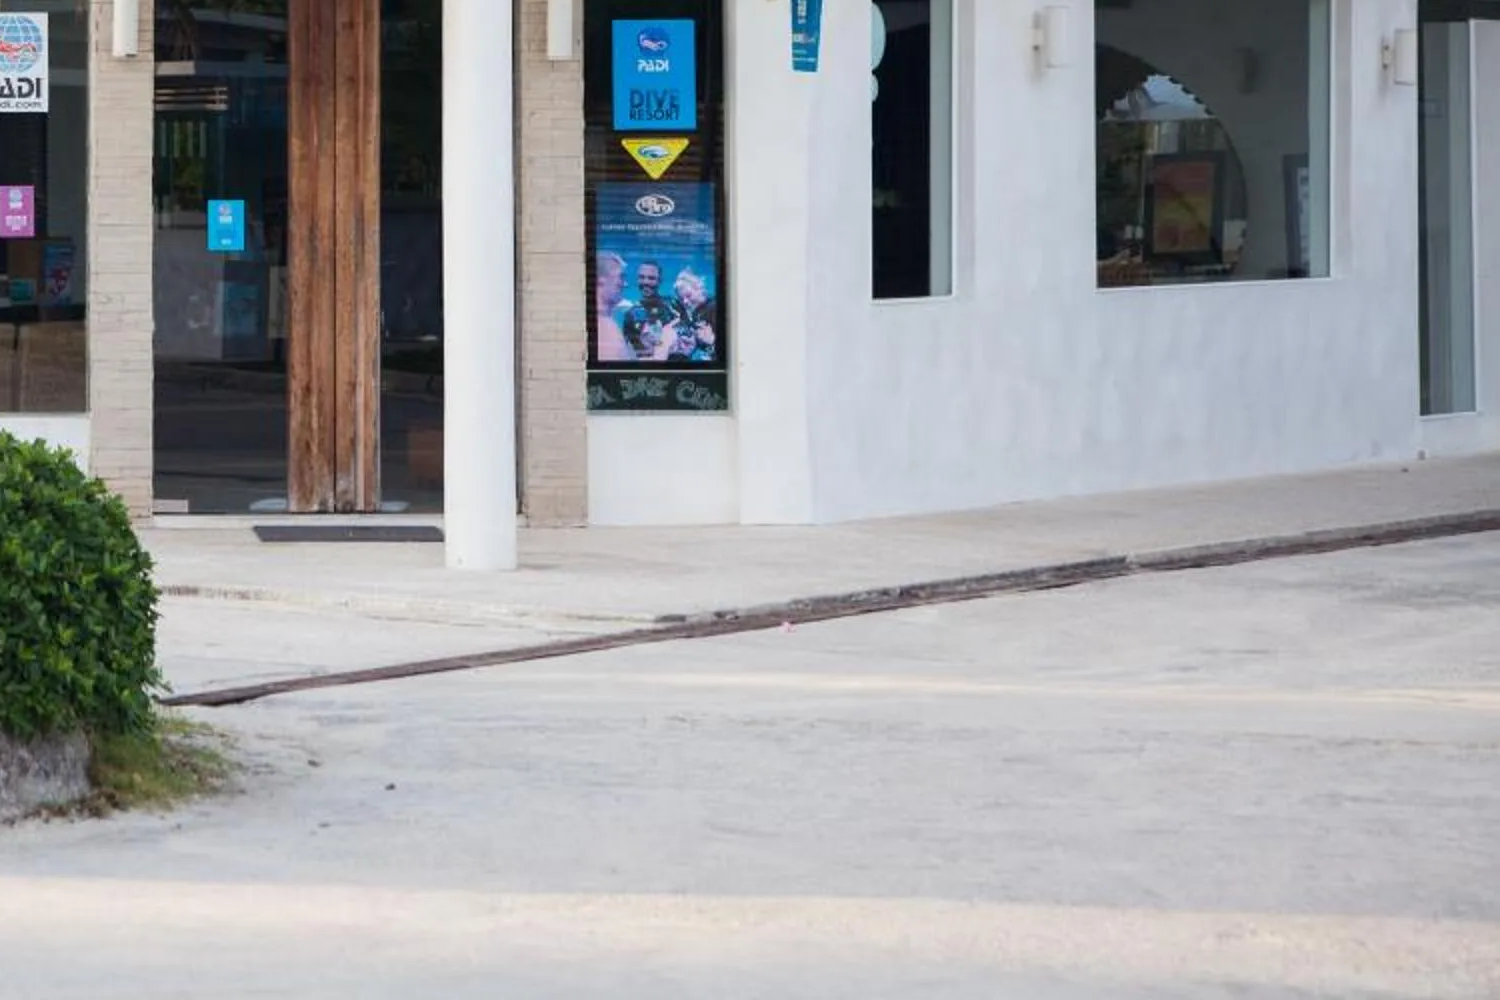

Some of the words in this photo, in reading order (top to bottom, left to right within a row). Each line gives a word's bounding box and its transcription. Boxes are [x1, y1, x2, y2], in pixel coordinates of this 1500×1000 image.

[638, 59, 669, 73] PADI
[629, 88, 680, 109] DIVE
[629, 108, 680, 121] RESORT
